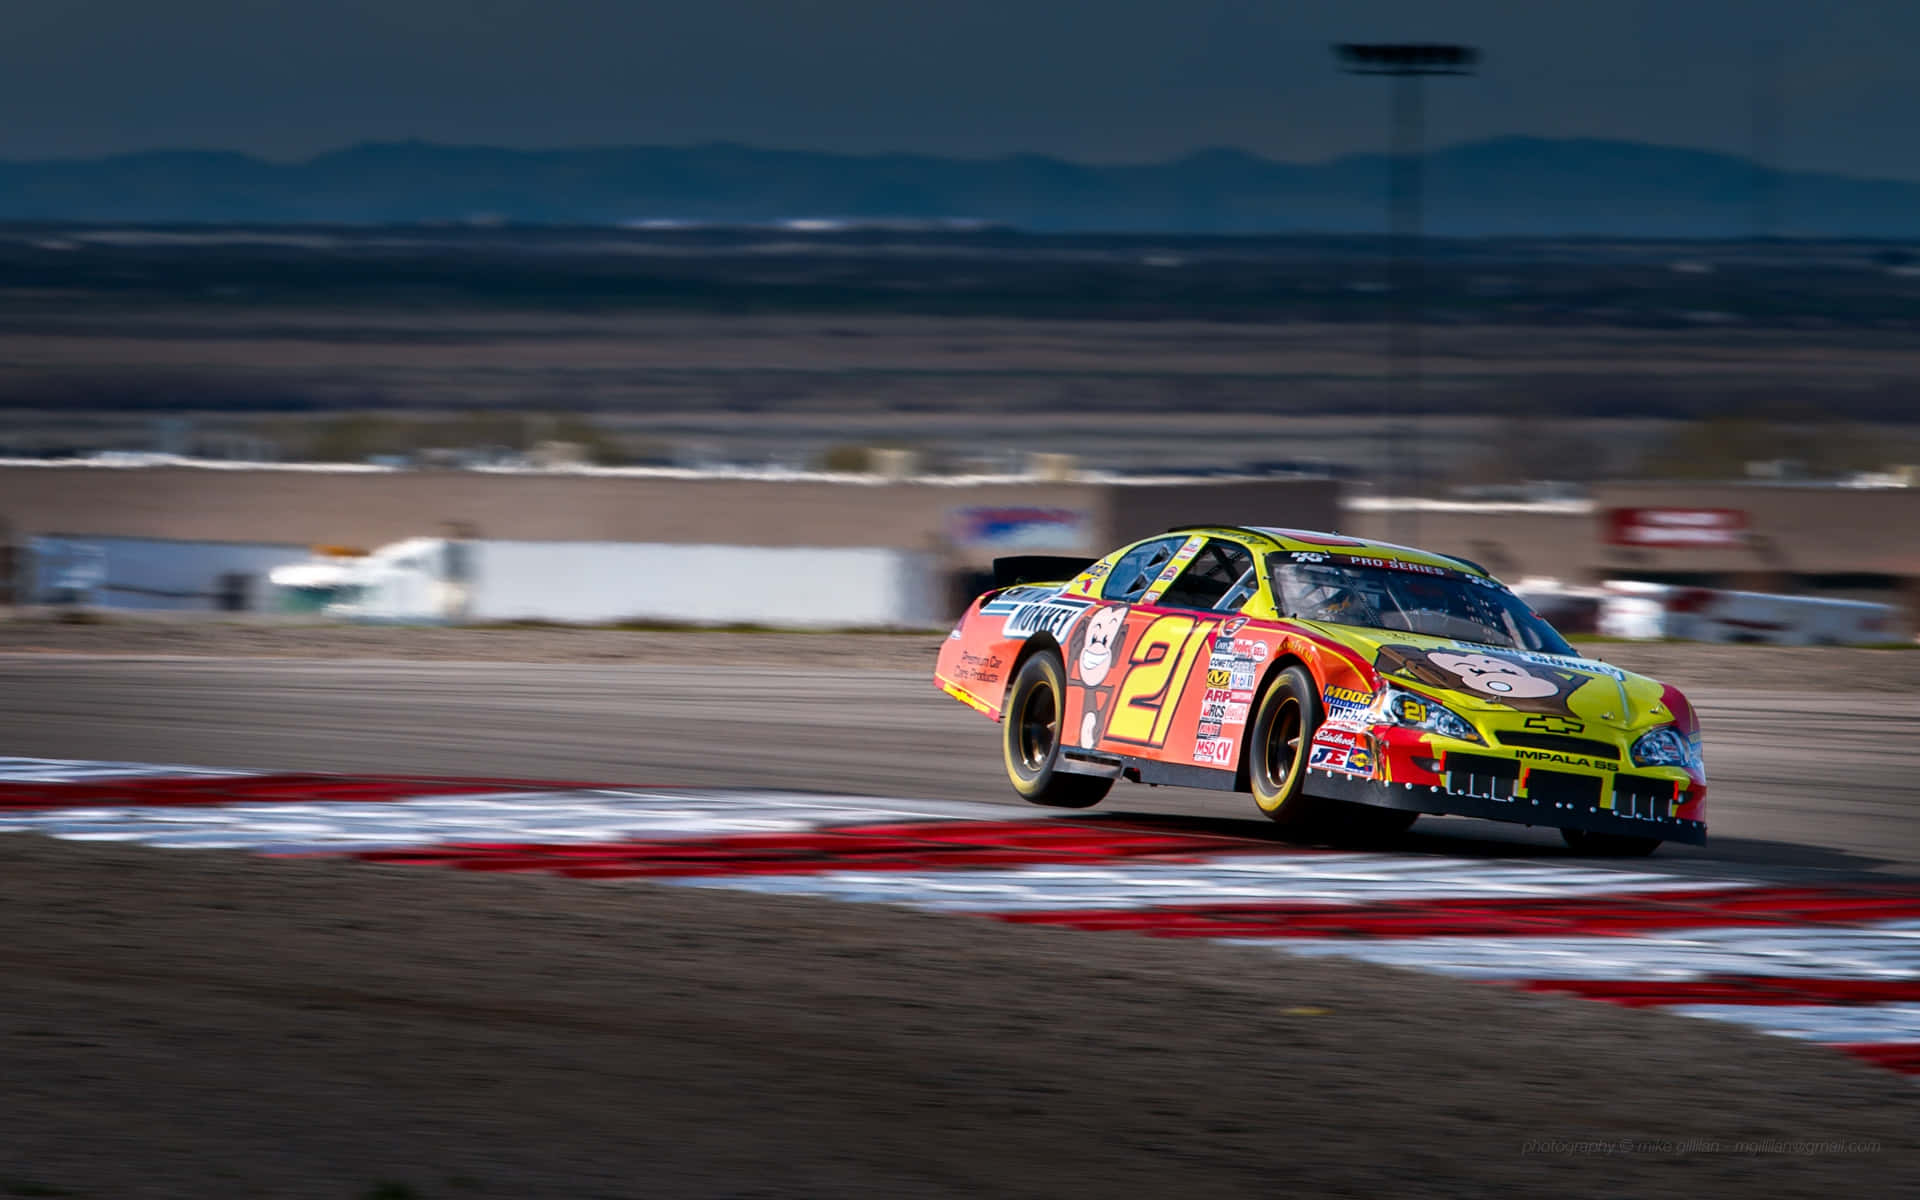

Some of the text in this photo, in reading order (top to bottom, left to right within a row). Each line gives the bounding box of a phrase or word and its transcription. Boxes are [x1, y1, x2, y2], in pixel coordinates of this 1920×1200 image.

[1351, 556, 1445, 576] PRO SERIES
[1103, 612, 1222, 749] 21
[1205, 689, 1232, 702] ARP
[1325, 685, 1374, 705] MOOG
[1403, 700, 1427, 722] 21
[1196, 741, 1216, 755] MSD
[1310, 747, 1348, 766] JE
[1515, 750, 1619, 772] IMPALA SS
